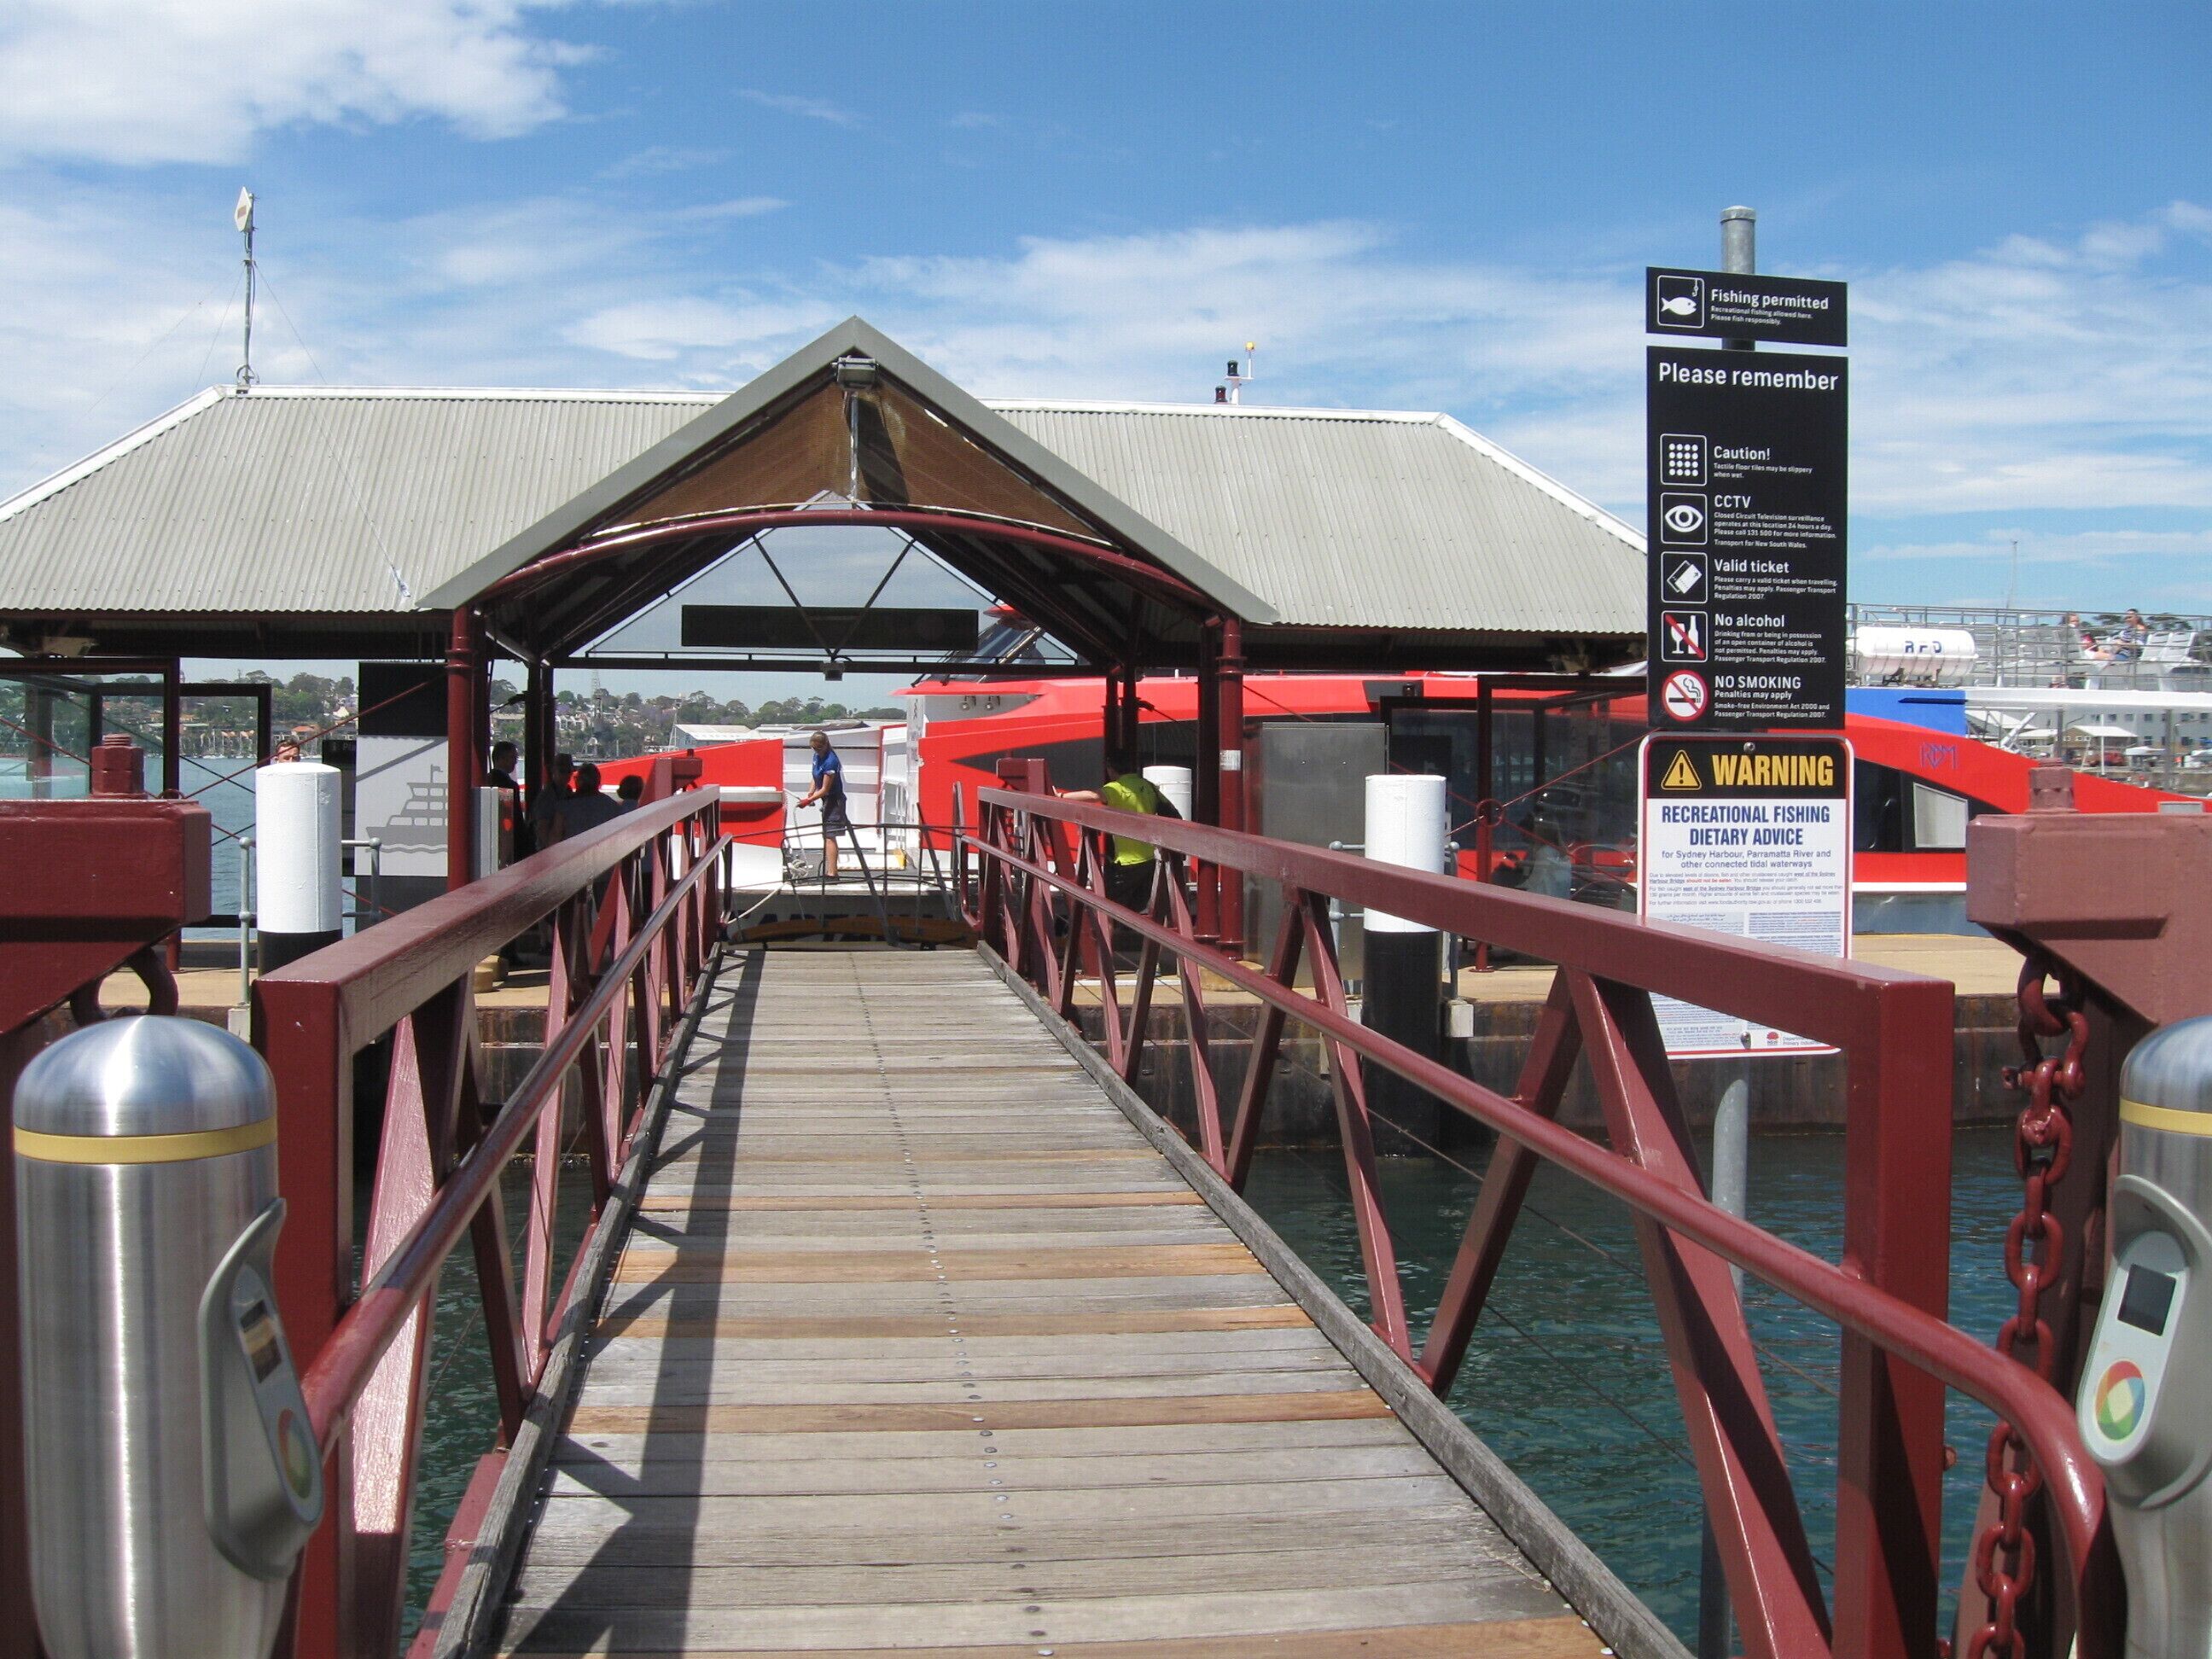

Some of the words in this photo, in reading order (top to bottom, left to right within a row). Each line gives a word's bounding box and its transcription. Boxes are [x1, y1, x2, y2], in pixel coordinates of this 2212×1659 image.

[1711, 289, 1760, 307] Fishing
[1762, 295, 1829, 310] permitted
[1659, 363, 1726, 384] Please
[1732, 370, 1838, 390] remember
[1714, 445, 1771, 460] Caution!
[1714, 495, 1751, 508] CCTV
[1714, 559, 1747, 572] Valid
[1750, 561, 1790, 573] ticket
[1715, 614, 1732, 626] No
[1737, 614, 1784, 627] alcohol
[1715, 676, 1735, 688] NO
[1738, 676, 1801, 689] SMOKING
[1771, 691, 1792, 700] apply
[1712, 755, 1834, 786] WARNING
[1662, 806, 1768, 824] RECREATIONAL
[1773, 806, 1830, 823] FISHING
[1691, 829, 1748, 845] DIETARY
[1753, 829, 1803, 845] ADVICE
[1662, 850, 1674, 859] for
[1676, 850, 1707, 860] Sydney
[1709, 851, 1744, 859] Harbour,
